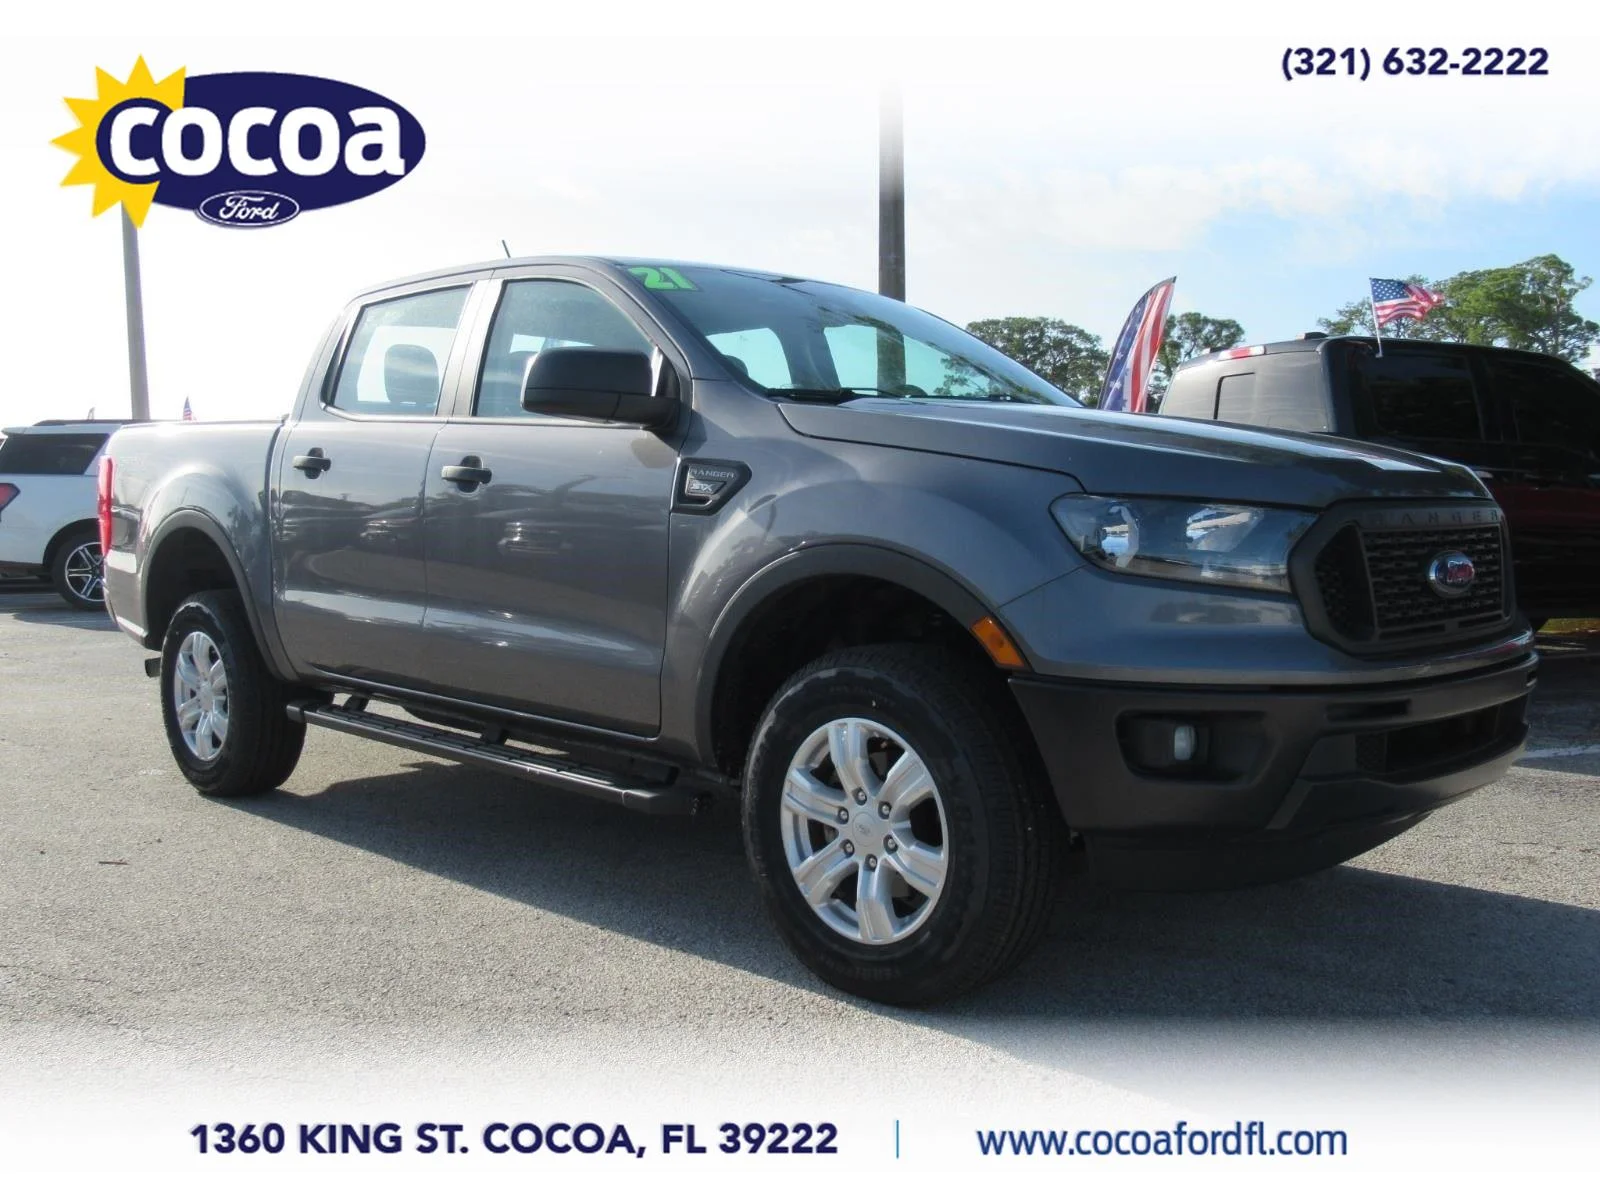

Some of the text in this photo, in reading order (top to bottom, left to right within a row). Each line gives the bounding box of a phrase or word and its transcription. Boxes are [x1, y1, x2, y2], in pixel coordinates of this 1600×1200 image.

[628, 267, 698, 290] 21
[690, 468, 735, 478] RANGER
[691, 483, 715, 492] STX
